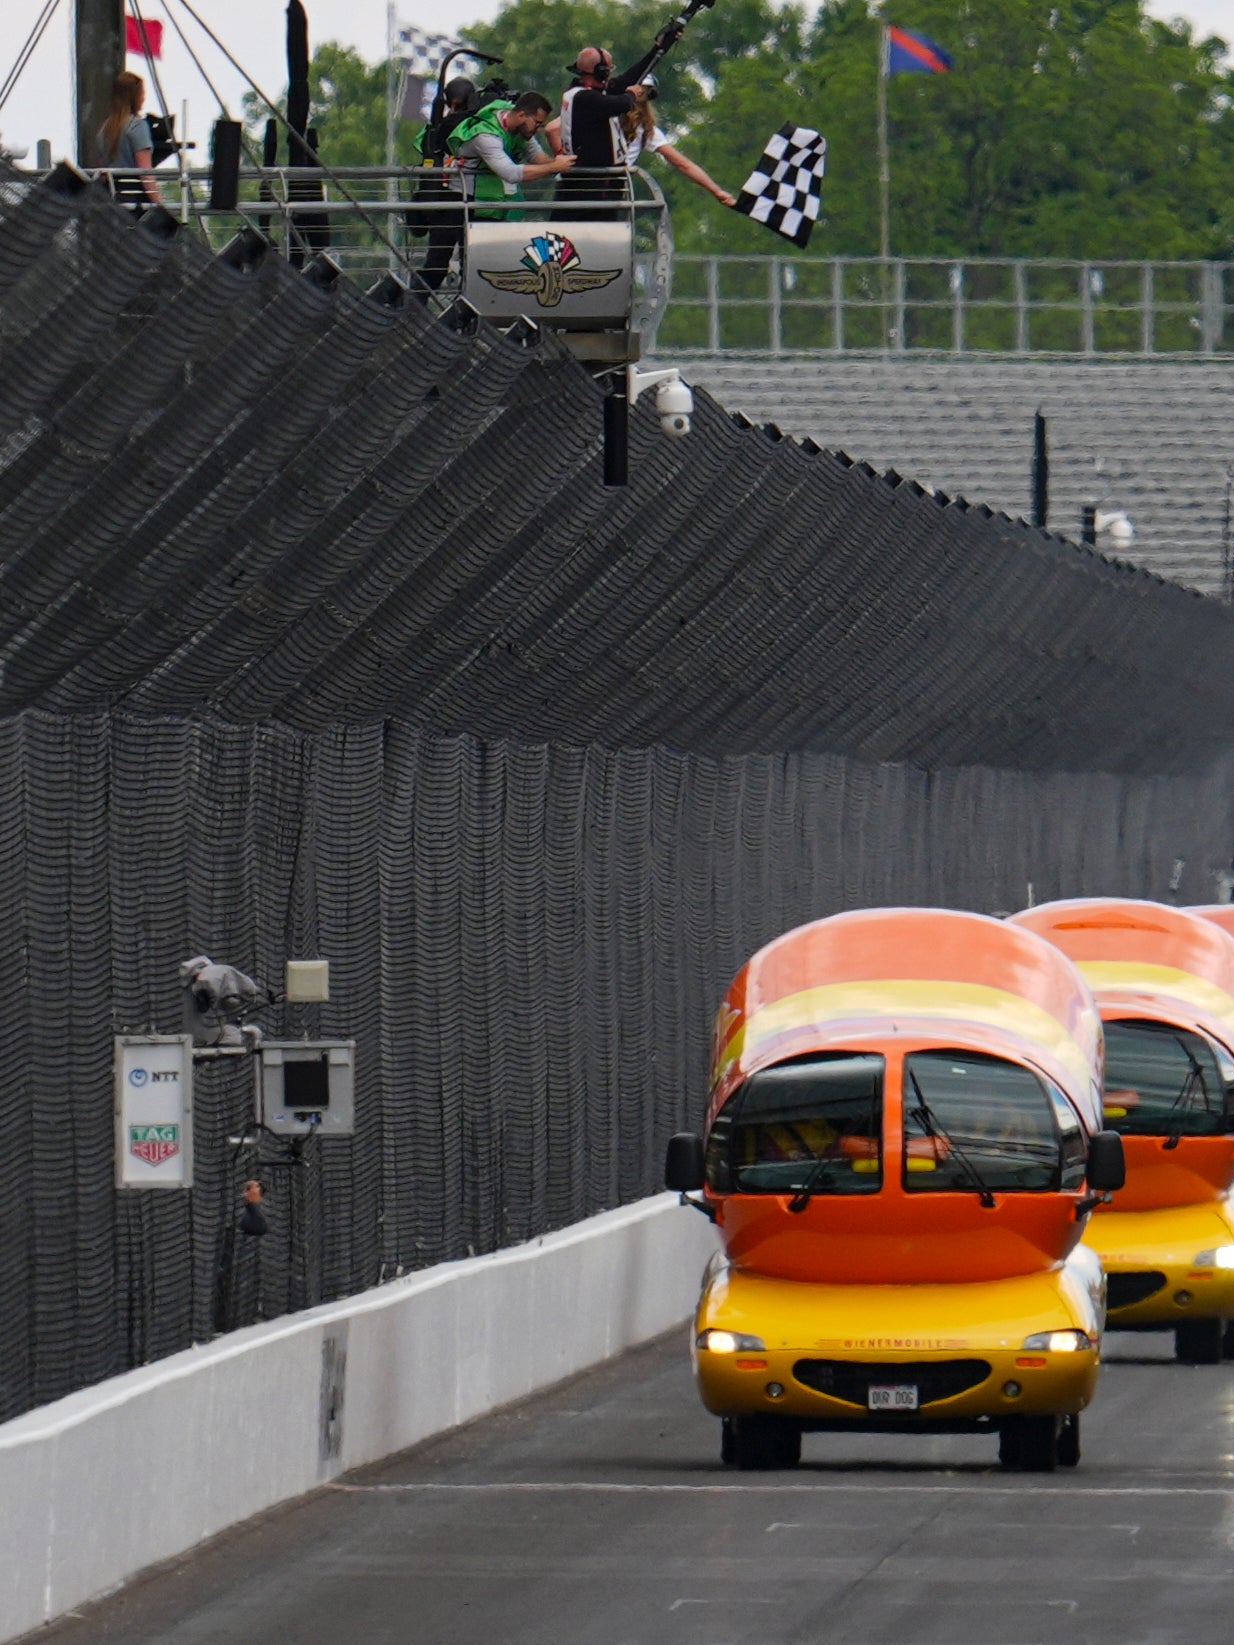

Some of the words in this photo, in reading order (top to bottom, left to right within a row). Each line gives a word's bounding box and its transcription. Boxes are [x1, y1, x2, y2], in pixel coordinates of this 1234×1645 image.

[151, 1071, 179, 1082] NTT
[131, 1126, 177, 1141] TAG
[132, 1141, 178, 1163] HEUER
[843, 1338, 944, 1349] WIENERMOBILE
